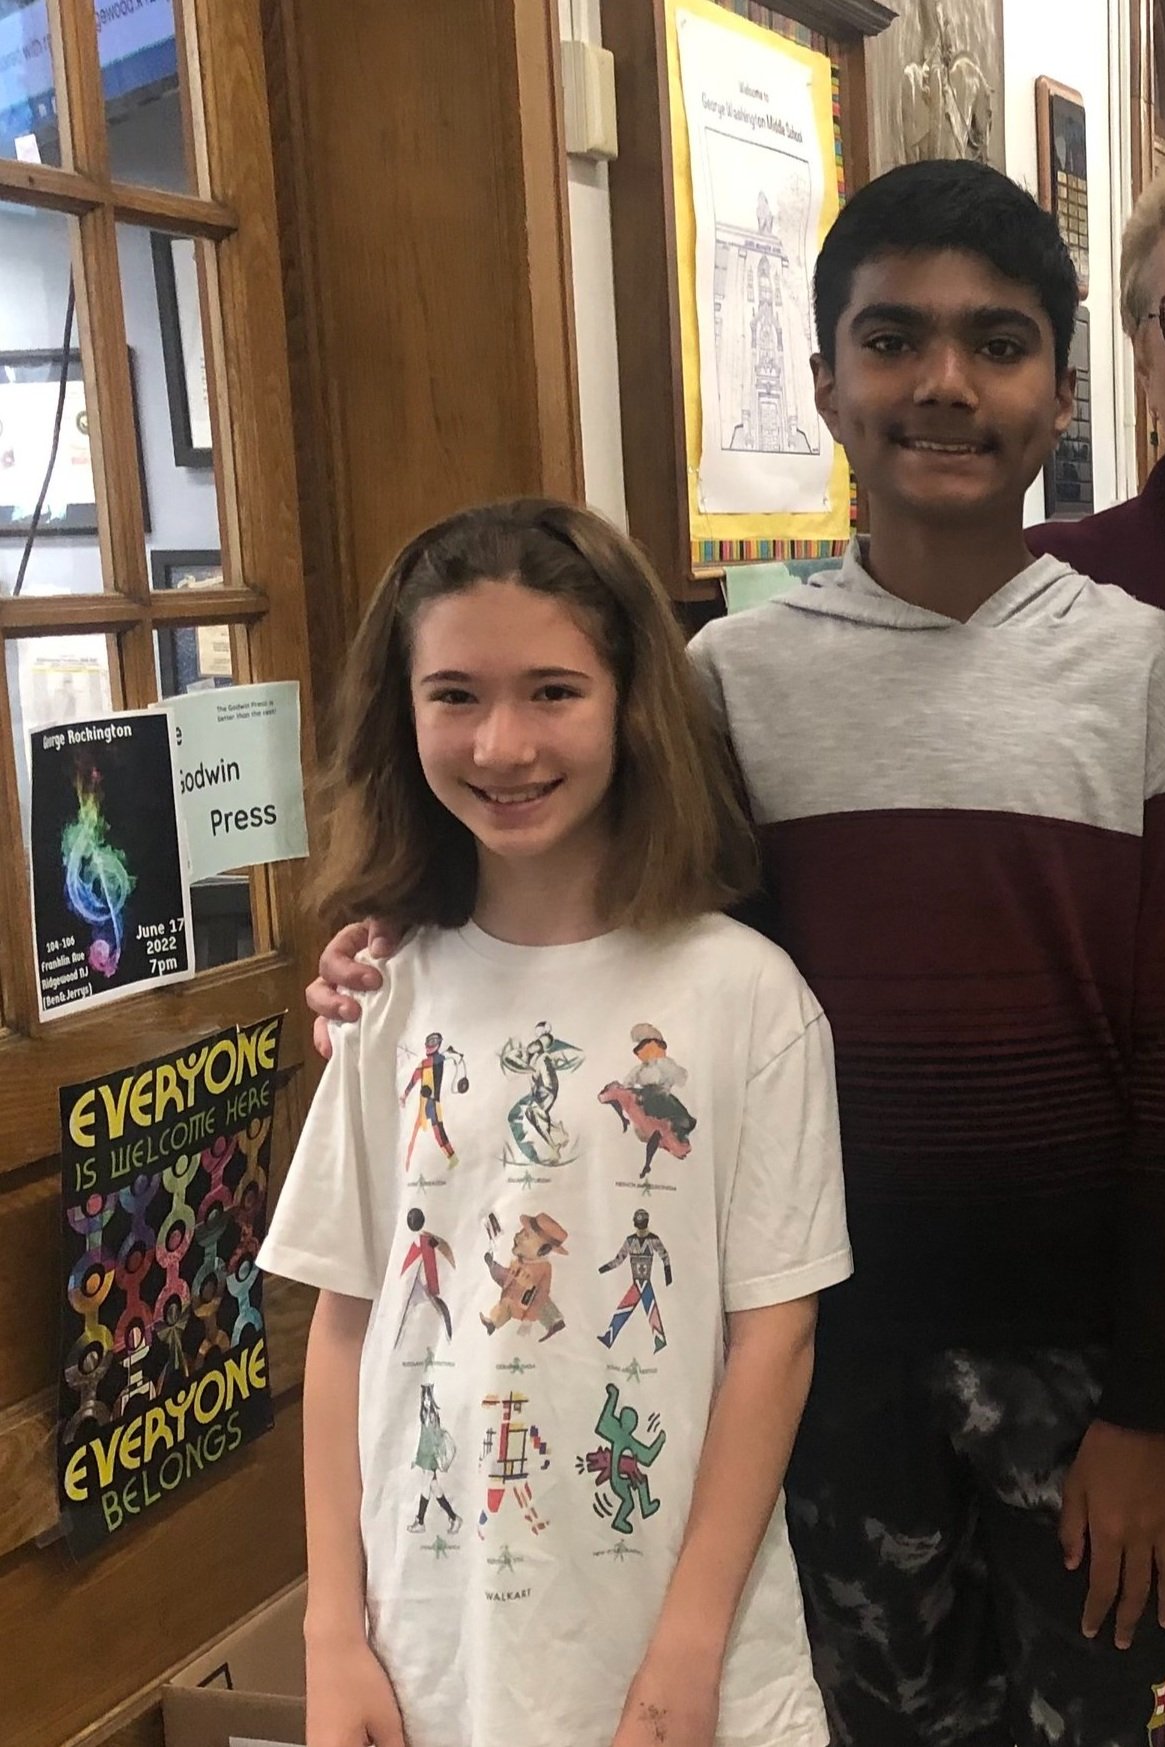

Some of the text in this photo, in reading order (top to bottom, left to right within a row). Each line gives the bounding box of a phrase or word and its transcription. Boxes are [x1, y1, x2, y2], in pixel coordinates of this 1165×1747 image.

[701, 91, 726, 120] George
[726, 101, 766, 131] Washington
[67, 723, 132, 744] Rockington
[210, 804, 277, 836] Press
[136, 917, 185, 940] June 17
[46, 935, 75, 953] 104-106
[146, 936, 177, 955] 2022
[41, 956, 71, 972] Franklin
[149, 957, 178, 976] 7pm
[41, 970, 78, 990] Ridgewood
[69, 1019, 278, 1148] EVERYONE
[75, 1079, 270, 1192] IS WELCOME HERE
[64, 1337, 266, 1501] EVERYONE
[102, 1411, 242, 1532] BELONGS
